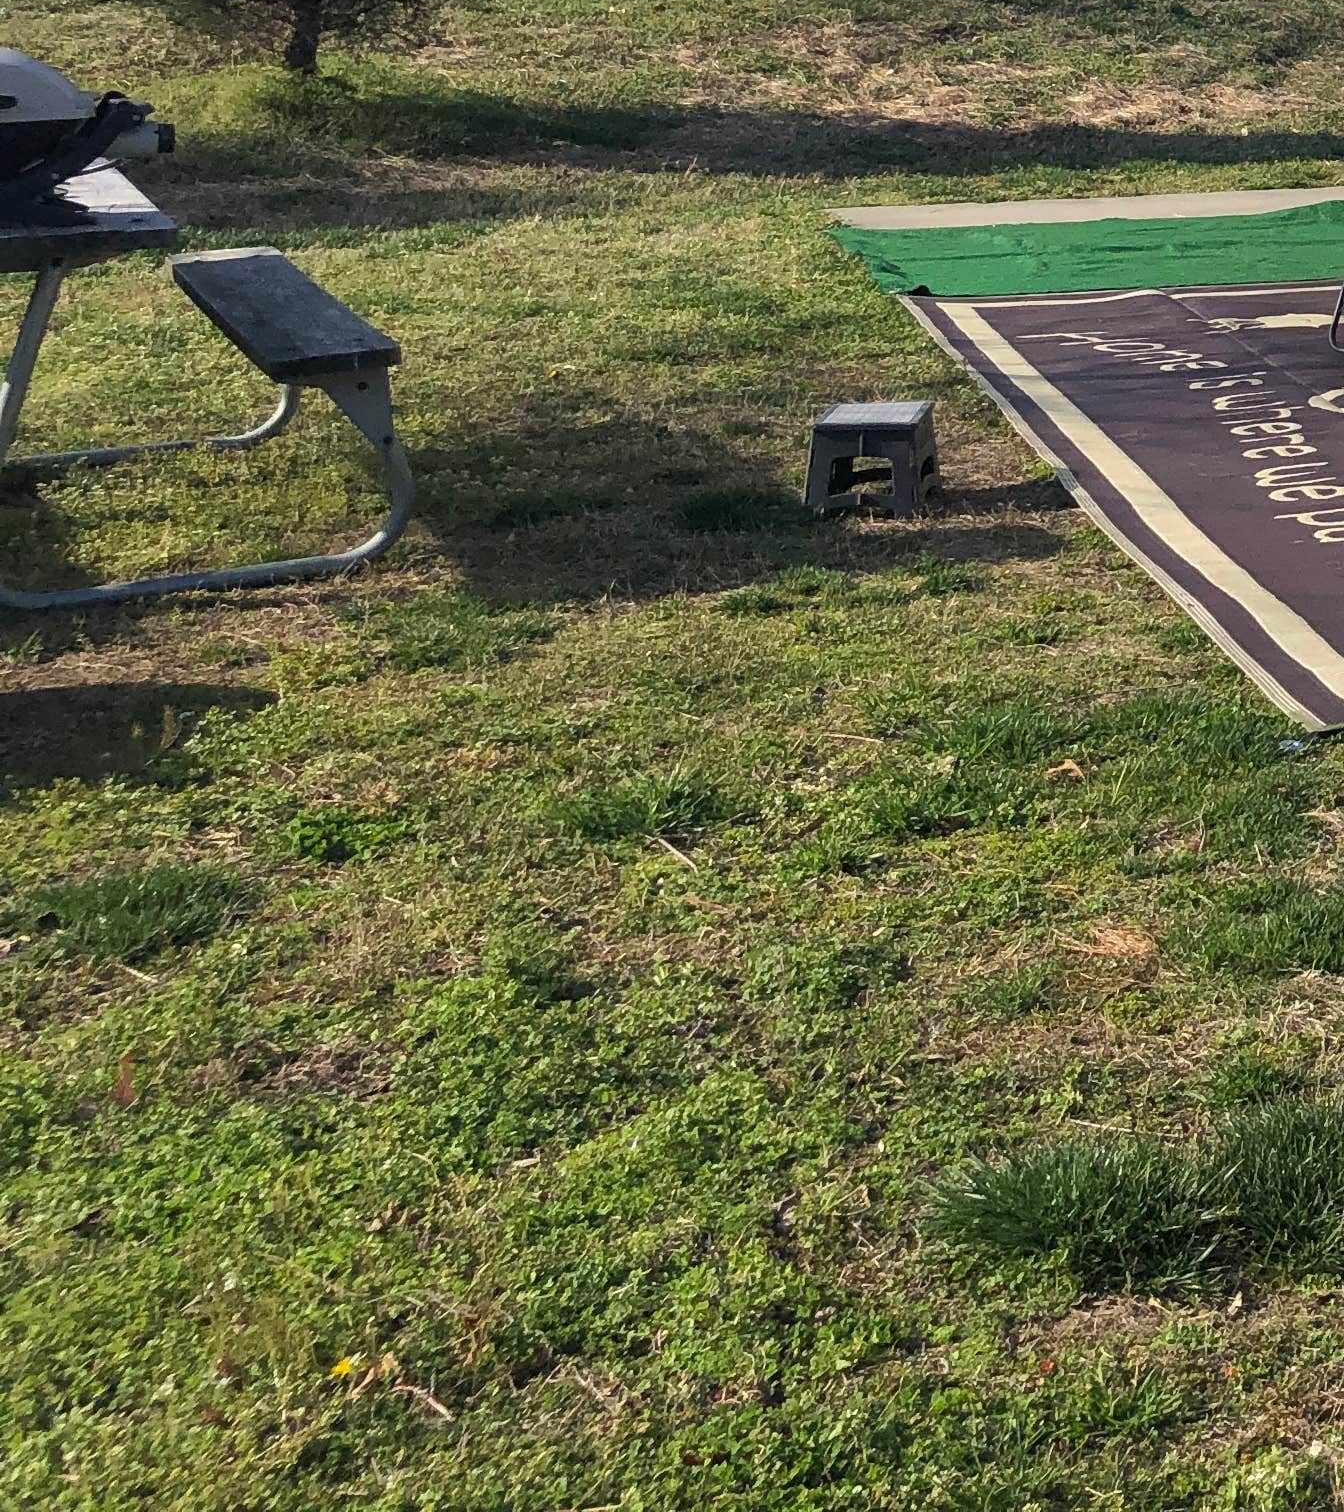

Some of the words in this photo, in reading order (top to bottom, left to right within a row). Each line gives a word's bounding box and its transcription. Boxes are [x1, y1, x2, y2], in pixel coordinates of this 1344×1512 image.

[1014, 331, 1229, 372] Home
[1186, 371, 1268, 390] is
[1211, 390, 1318, 459] where
